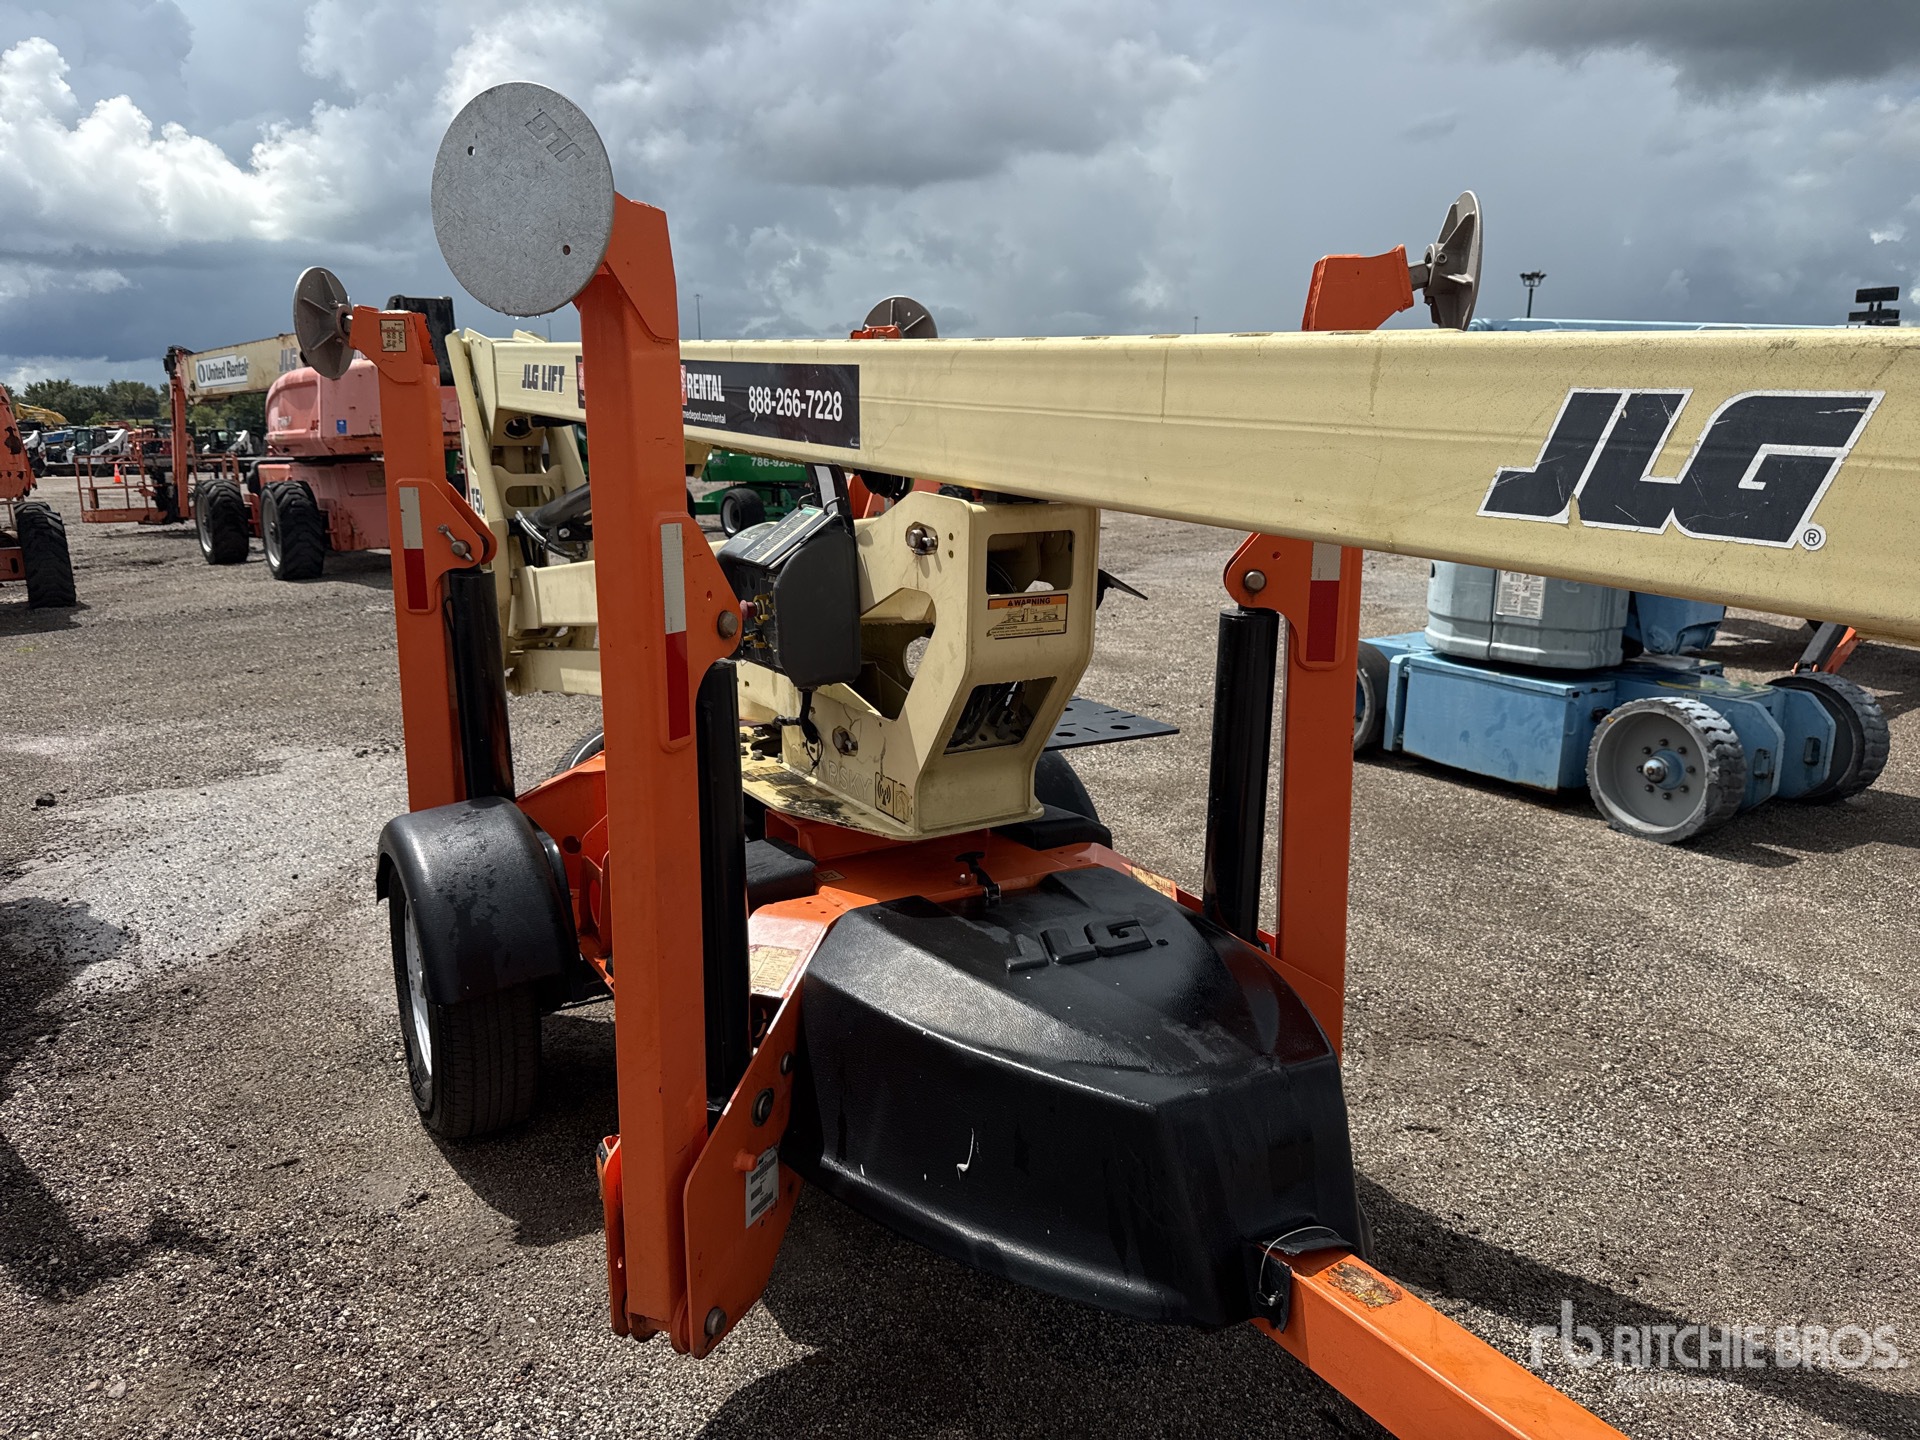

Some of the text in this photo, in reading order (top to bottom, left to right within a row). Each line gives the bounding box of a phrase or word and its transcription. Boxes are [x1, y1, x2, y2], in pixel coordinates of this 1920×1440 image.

[206, 361, 226, 381] United
[521, 363, 539, 391] JLG
[541, 364, 566, 395] LIFT
[686, 372, 726, 403] RENTAL
[748, 385, 843, 422] 888-266-7228
[1476, 387, 1886, 549] JLG
[1014, 597, 1051, 606] WARNING
[1004, 915, 1153, 973] JLG
